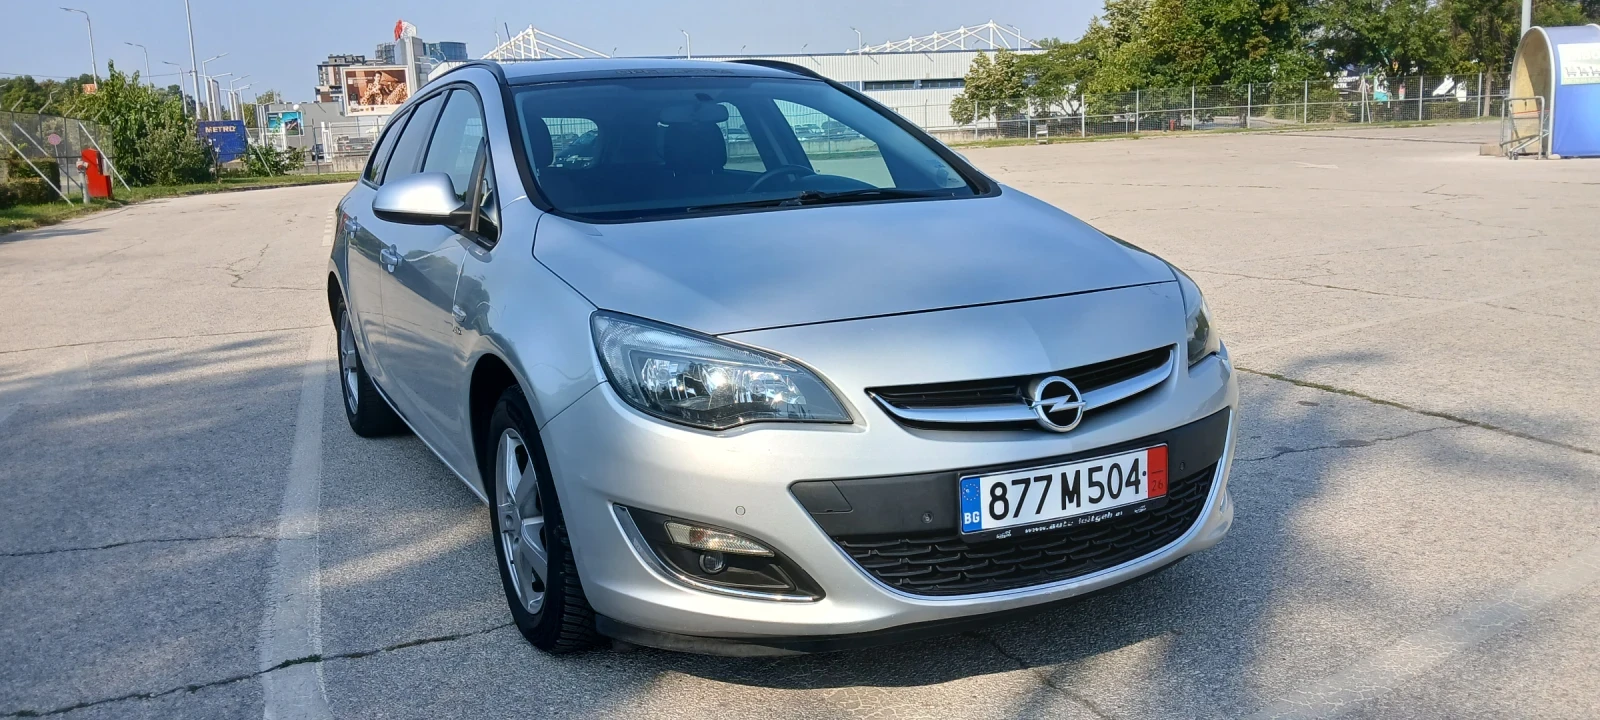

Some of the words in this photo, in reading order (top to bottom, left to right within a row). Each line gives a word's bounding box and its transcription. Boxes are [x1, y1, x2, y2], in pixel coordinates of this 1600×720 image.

[205, 125, 236, 133] METRO
[1151, 479, 1164, 492] 26
[964, 511, 980, 525] BG
